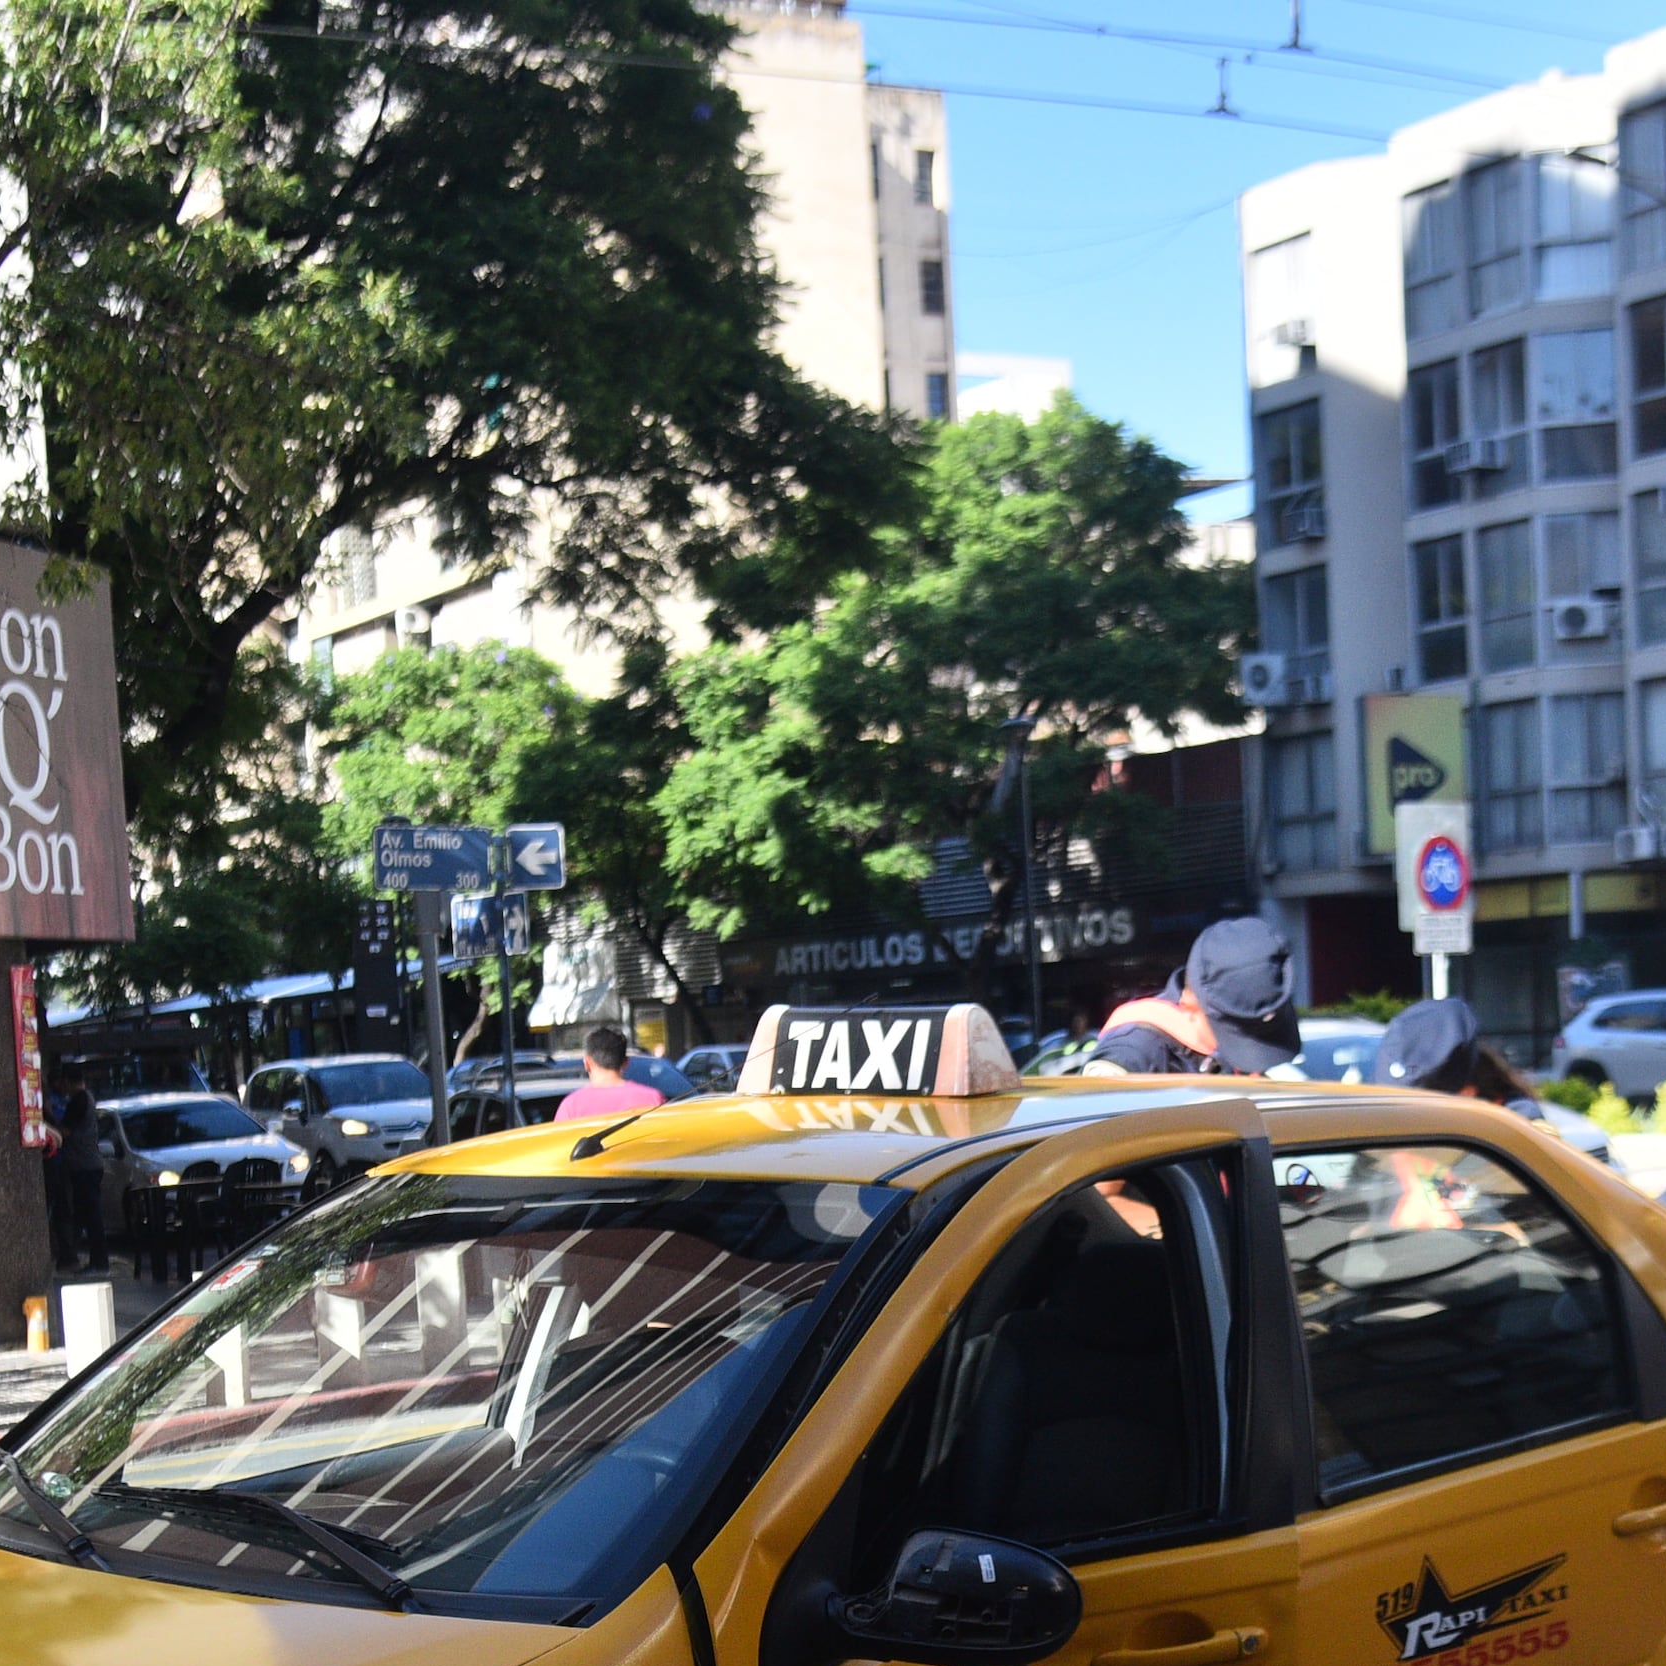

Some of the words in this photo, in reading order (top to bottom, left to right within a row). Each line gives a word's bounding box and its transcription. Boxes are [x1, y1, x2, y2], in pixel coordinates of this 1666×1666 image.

[380, 832, 404, 849] Av.
[413, 833, 463, 849] Emilio
[380, 852, 432, 868] Olmos
[383, 872, 410, 889] 400
[455, 873, 479, 889] 300
[774, 930, 925, 977] ARTICULOS
[788, 1019, 932, 1091] TAXI
[1375, 1581, 1416, 1619] 519
